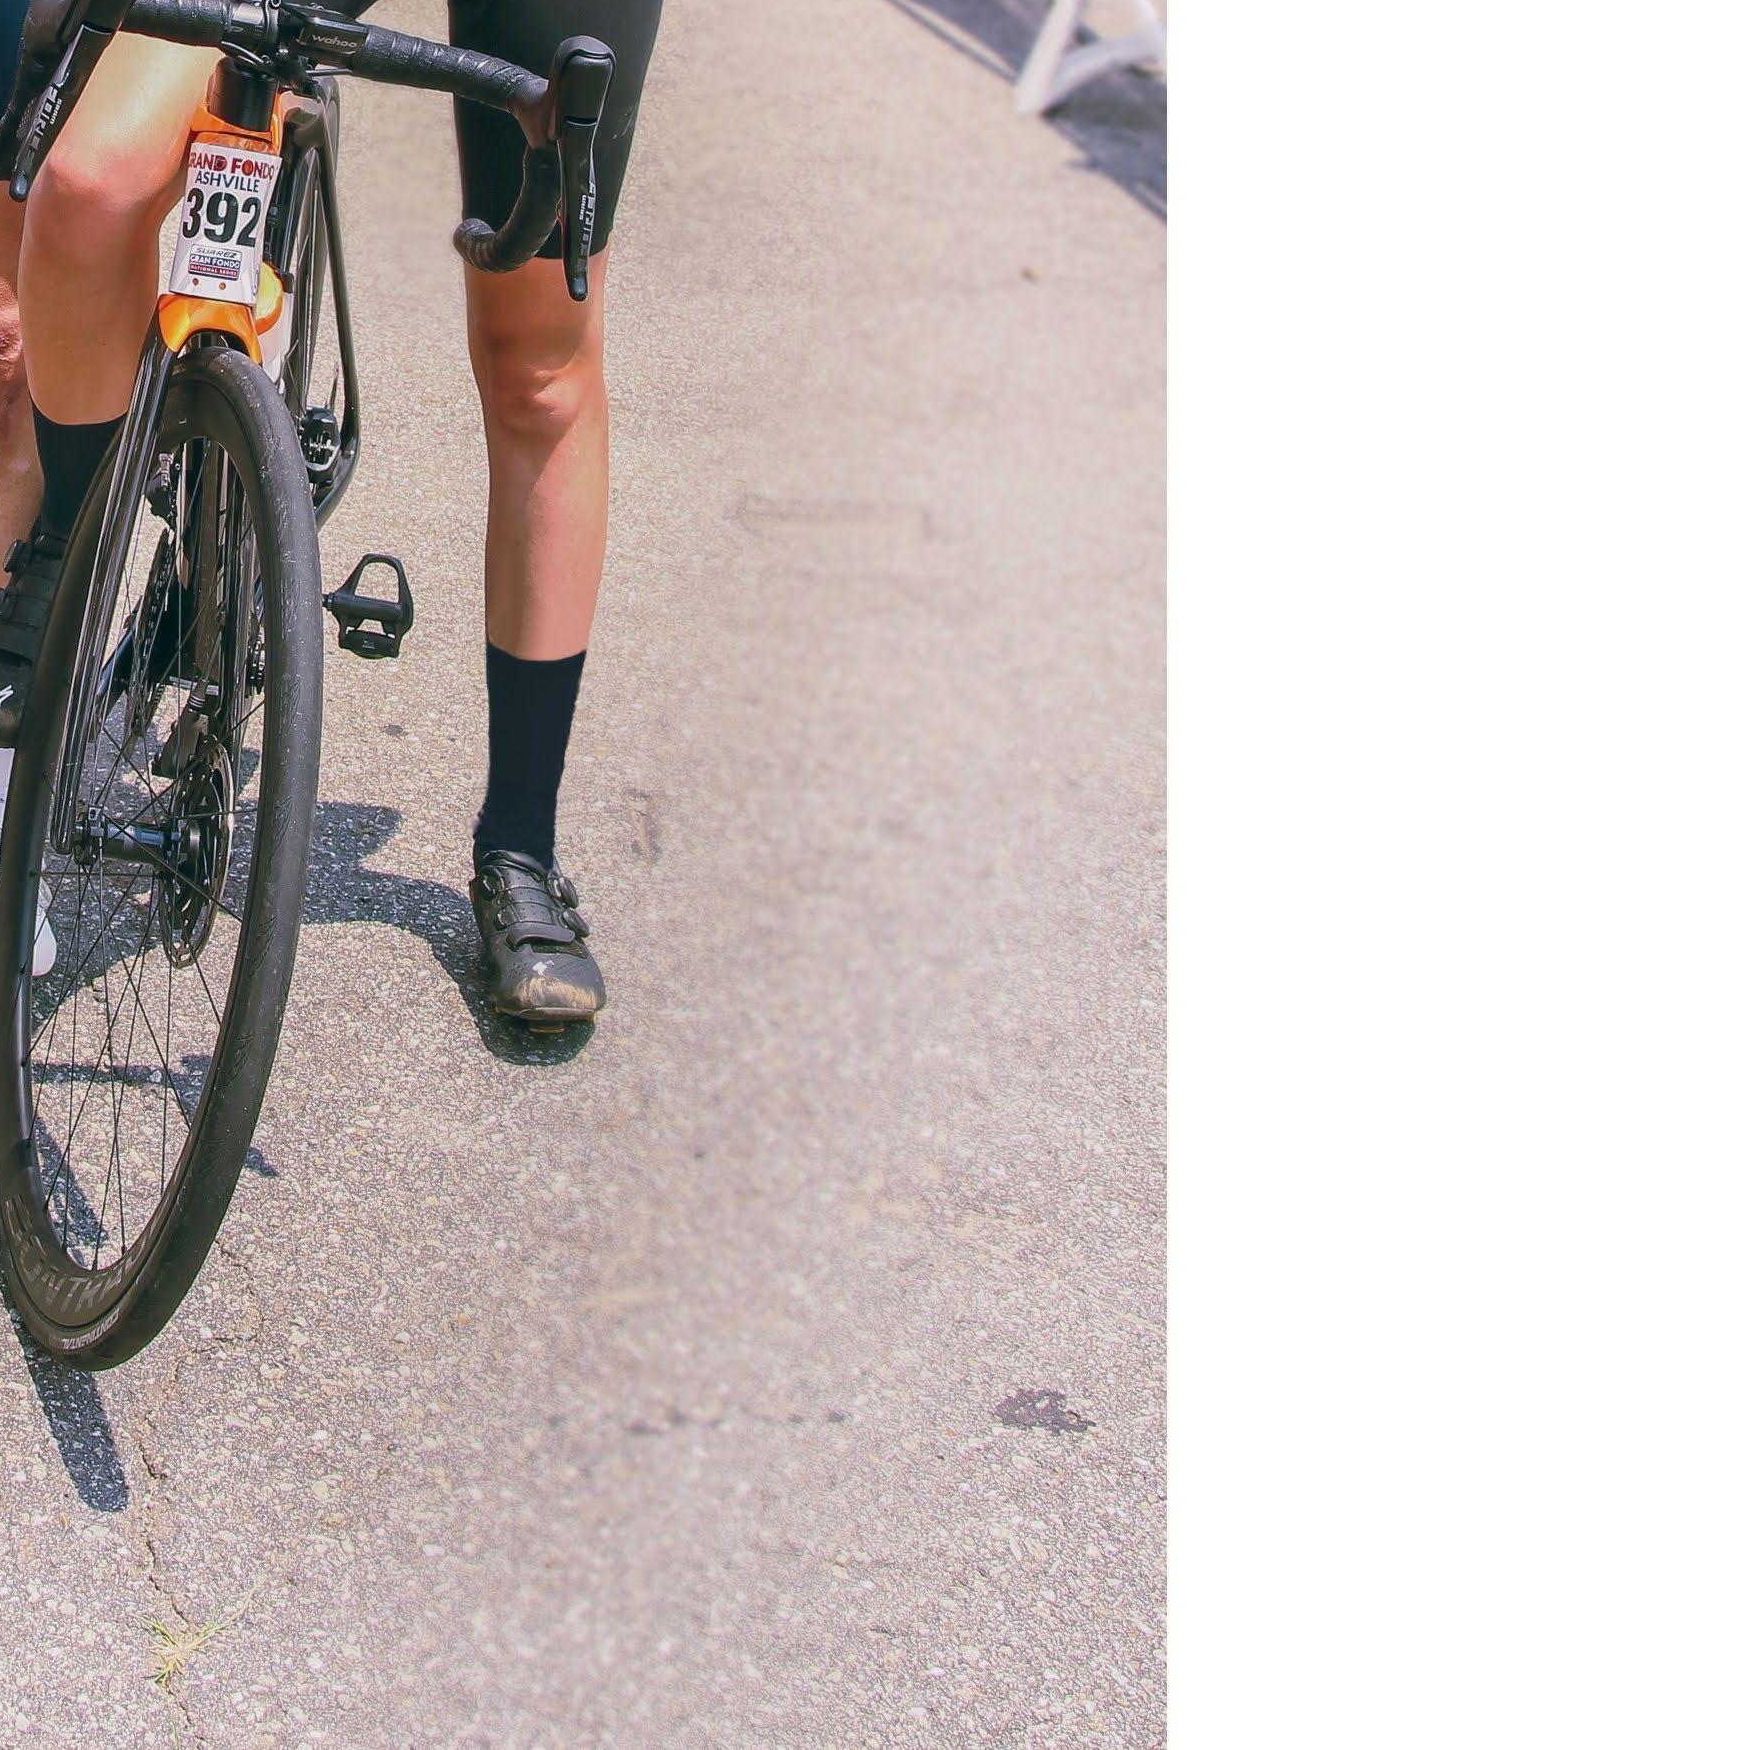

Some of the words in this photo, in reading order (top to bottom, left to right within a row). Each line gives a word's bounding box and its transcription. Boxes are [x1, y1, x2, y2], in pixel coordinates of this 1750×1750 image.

[311, 33, 358, 49] wahoo
[50, 97, 63, 125] SRAM
[230, 157, 276, 181] FONDO
[195, 171, 260, 193] ASHVILLE
[182, 188, 262, 248] 392
[578, 194, 587, 220] SRAM
[190, 255, 214, 267] GRAN
[214, 257, 241, 269] FONDO
[196, 246, 237, 259] SUAREZ
